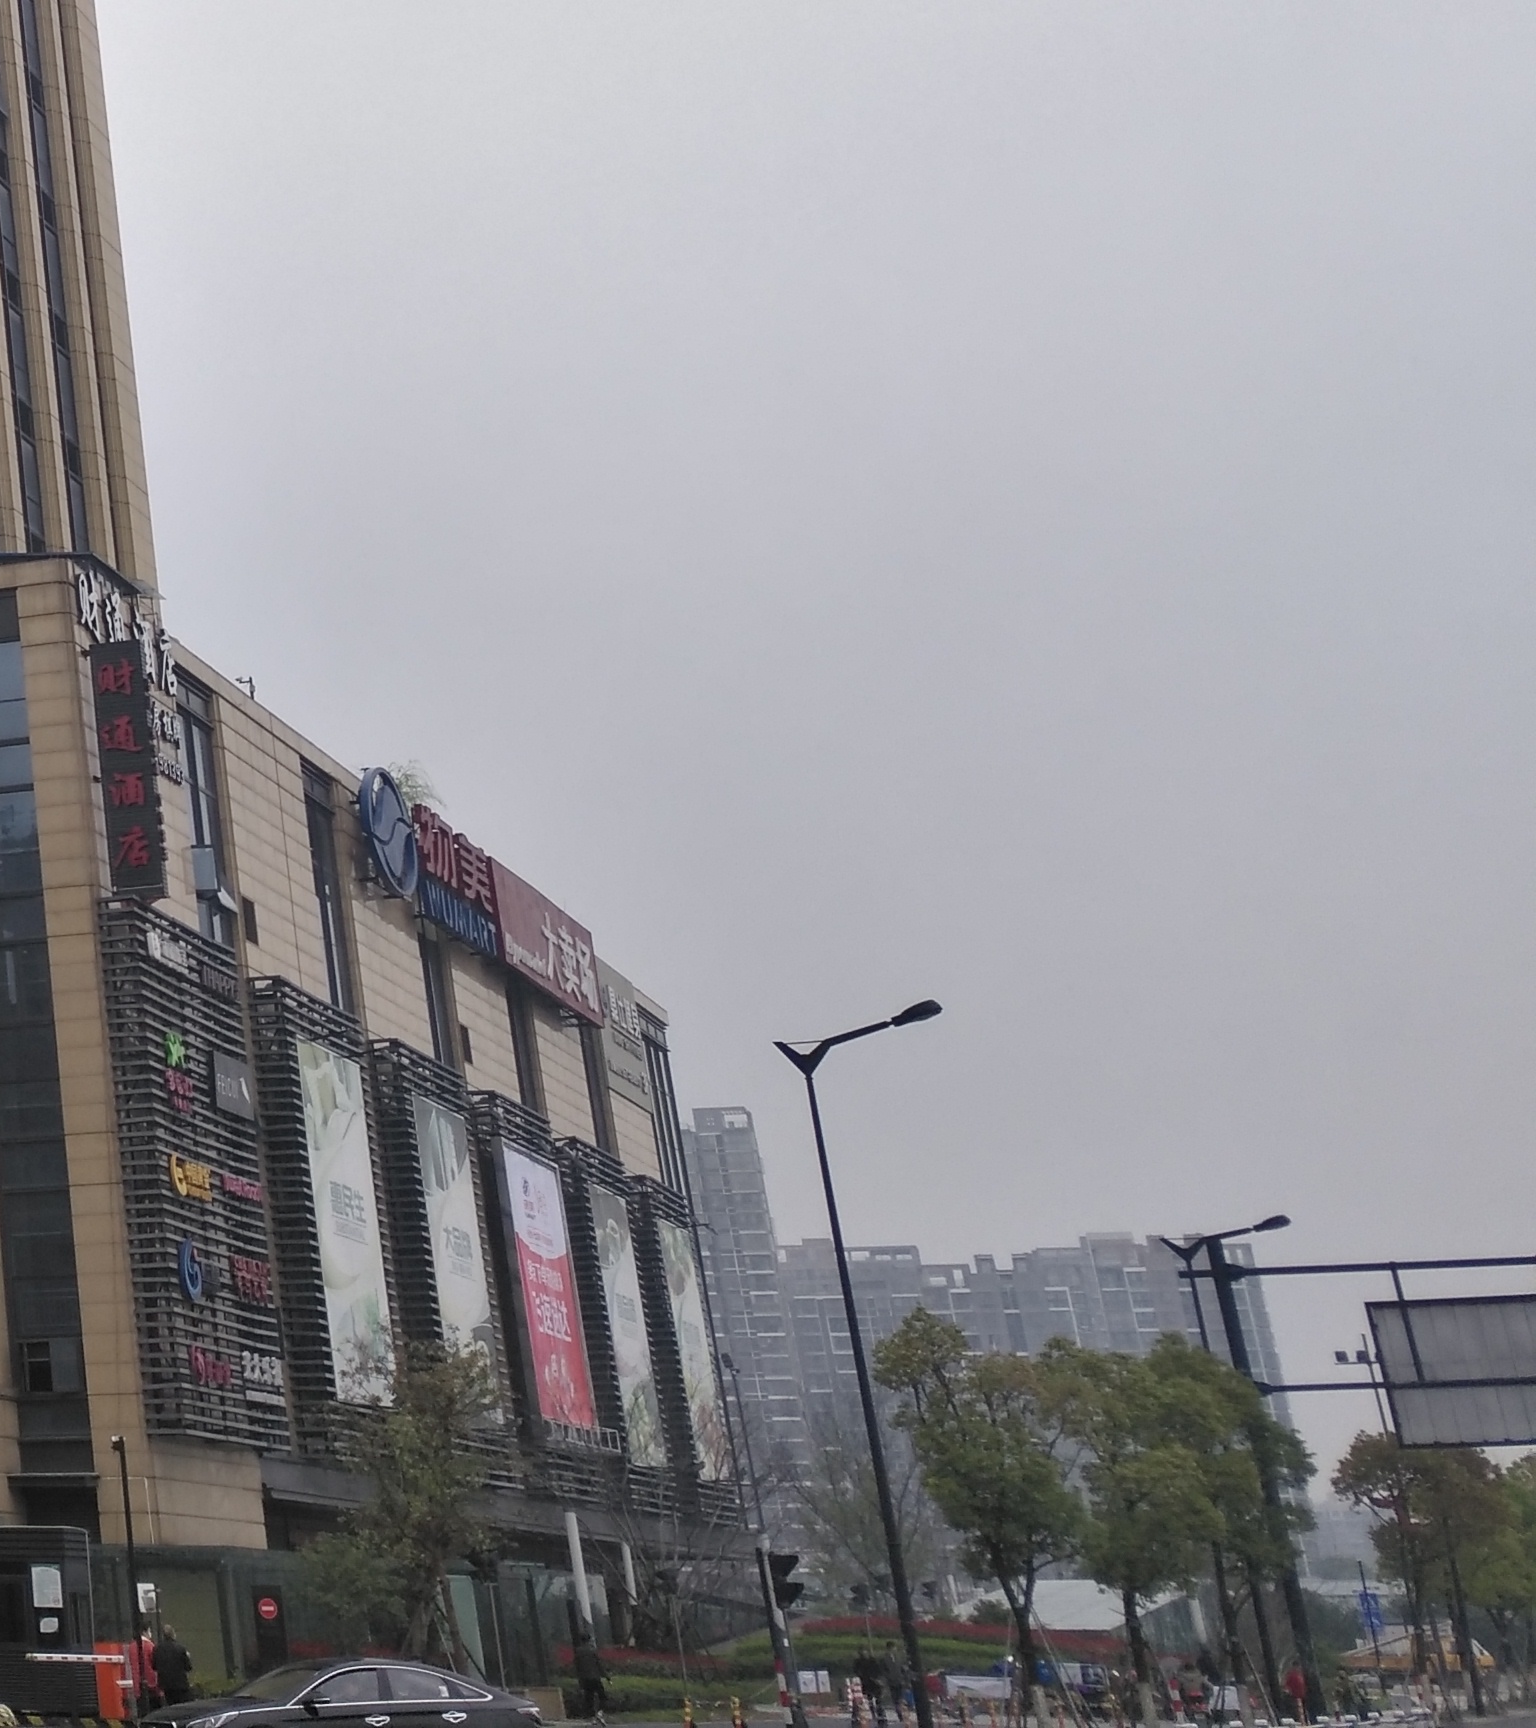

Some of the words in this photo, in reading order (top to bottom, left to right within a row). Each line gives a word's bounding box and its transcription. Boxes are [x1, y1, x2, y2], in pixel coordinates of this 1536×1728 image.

[97, 658, 151, 869] 财通酒店
[412, 804, 494, 914] 物美
[540, 911, 599, 1014] 大卖场
[329, 1180, 367, 1224] 惠民生
